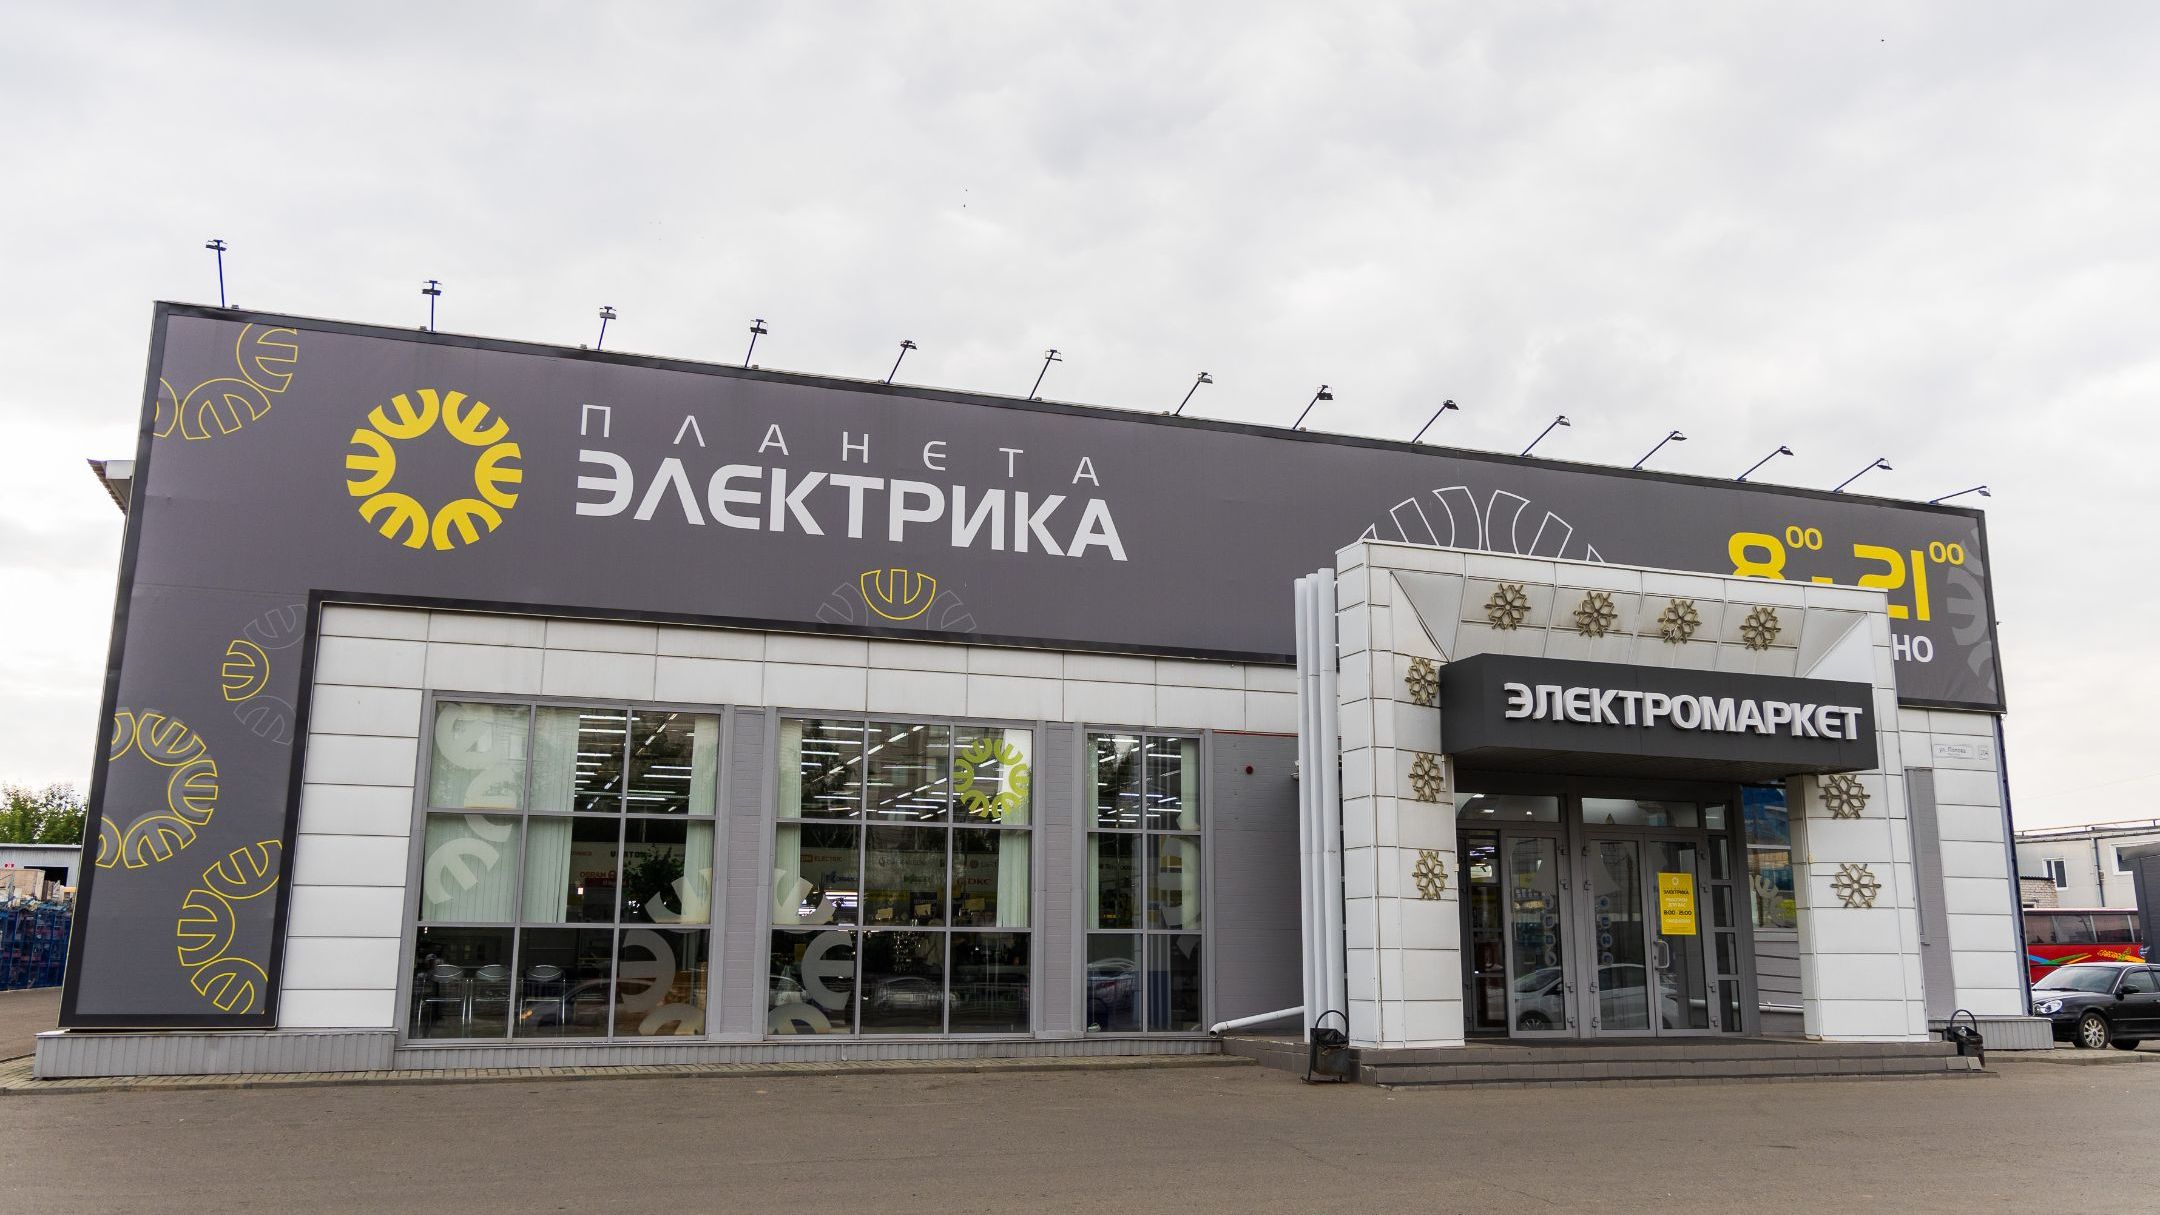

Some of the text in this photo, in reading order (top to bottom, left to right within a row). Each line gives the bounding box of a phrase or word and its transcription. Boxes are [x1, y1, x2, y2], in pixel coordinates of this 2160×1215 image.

[580, 404, 1100, 487] ПЛАНЕТА
[575, 449, 1129, 562] ЭЛЕКТРИКА
[1503, 681, 1863, 741] ЭЛЕКТРОМАРКЕТ
